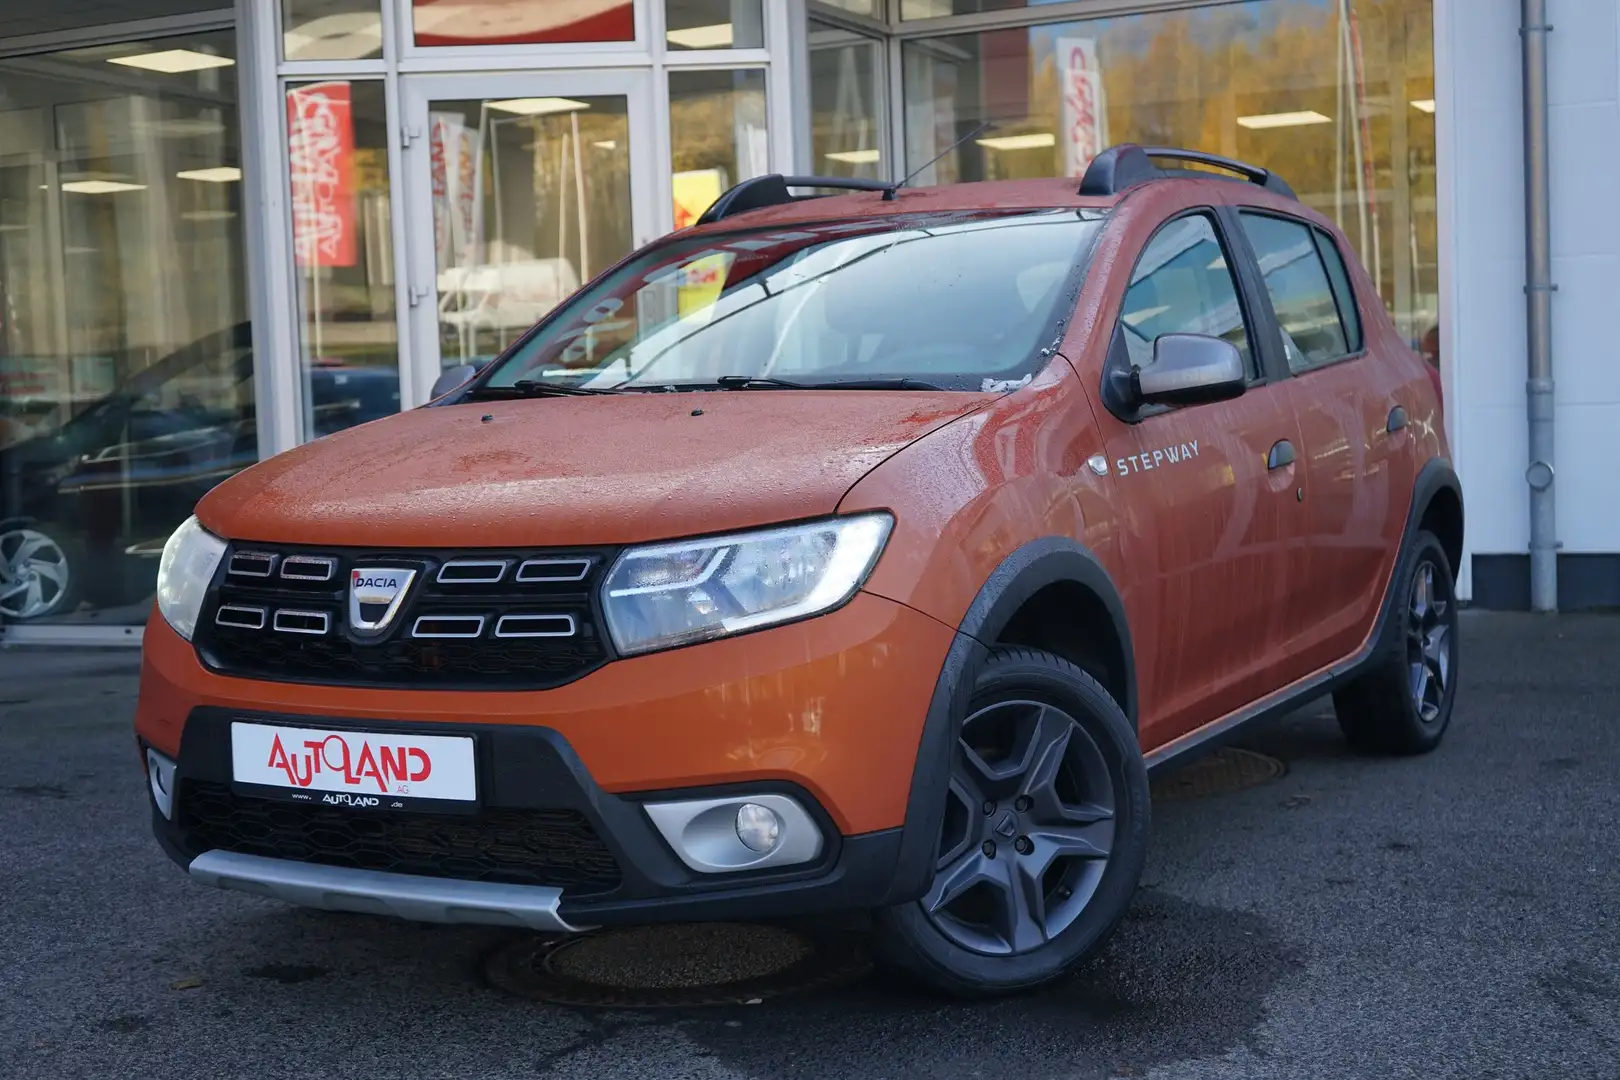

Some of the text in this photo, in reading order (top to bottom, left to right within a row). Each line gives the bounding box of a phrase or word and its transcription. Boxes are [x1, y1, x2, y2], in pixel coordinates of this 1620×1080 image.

[1116, 439, 1200, 476] STEPWAY
[355, 577, 397, 588] DACIA
[396, 784, 409, 794] AG
